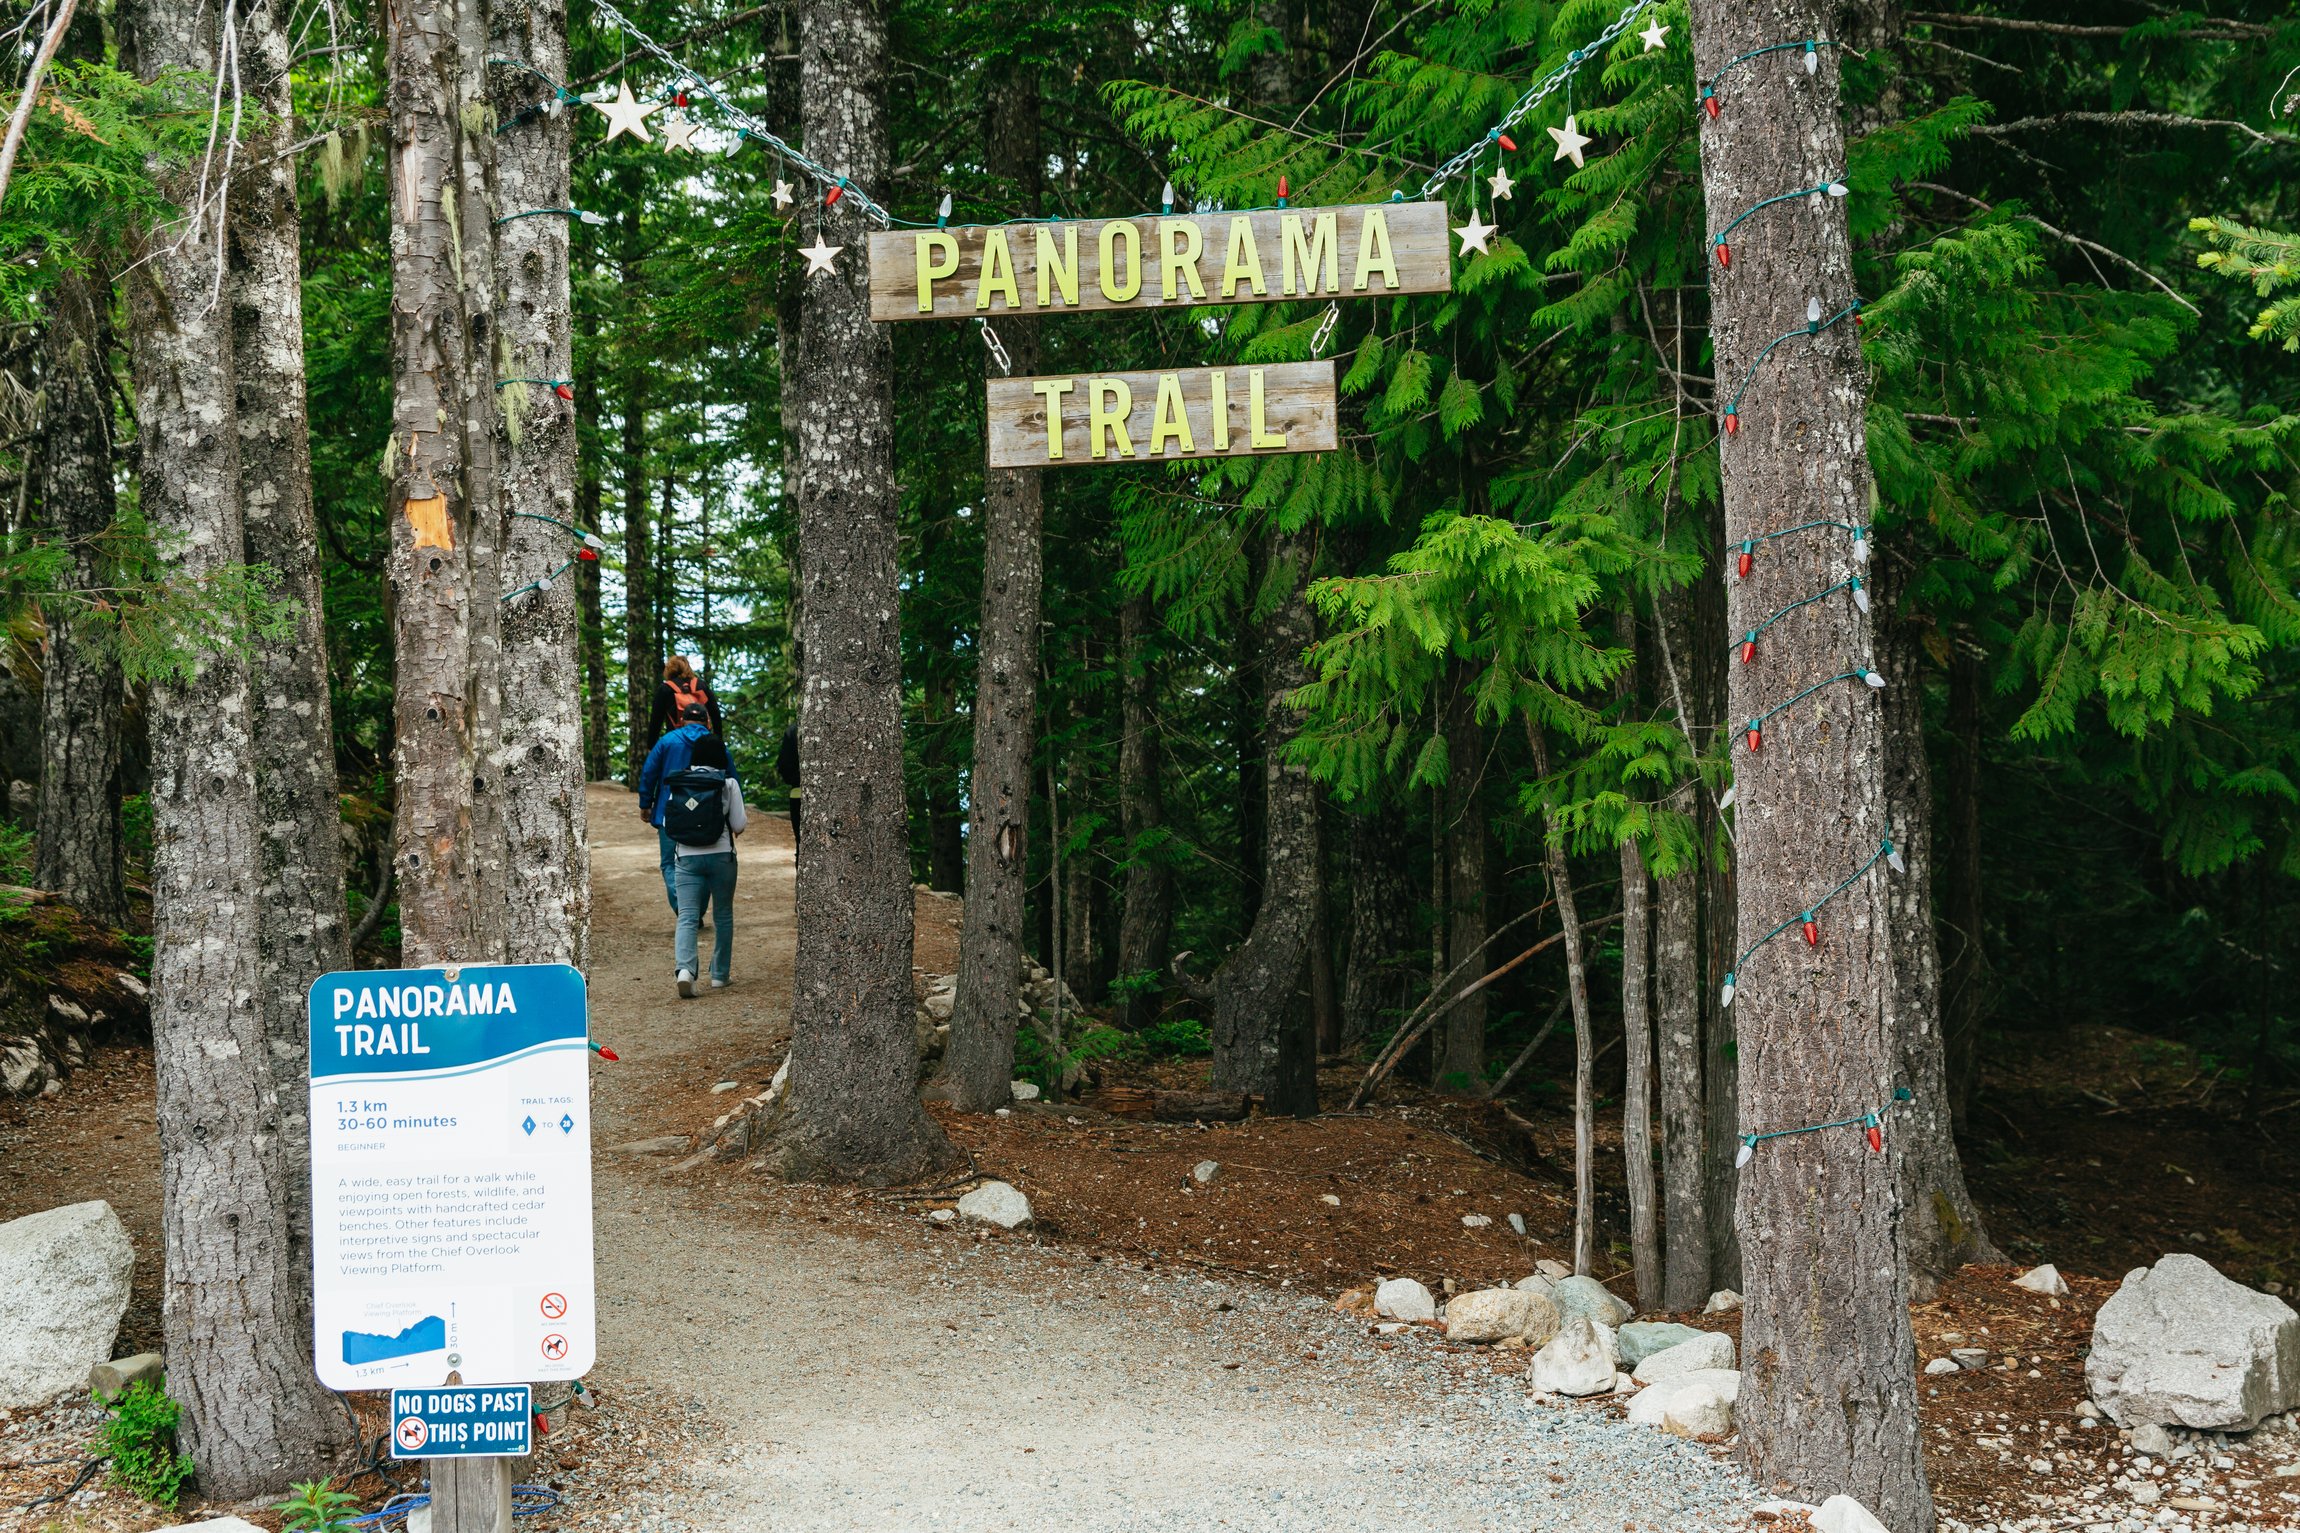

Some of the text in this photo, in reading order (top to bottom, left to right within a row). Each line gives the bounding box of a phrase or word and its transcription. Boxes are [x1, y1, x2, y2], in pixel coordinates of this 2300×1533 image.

[915, 209, 1400, 312] PANORAMA
[1033, 369, 1287, 459] TRAIL
[333, 983, 517, 1020] PANORAMA
[334, 1023, 430, 1056] TRAIL
[337, 1100, 387, 1113] 1.3 km
[337, 1115, 457, 1130] 30-60 minutes
[337, 1143, 386, 1151] BEGINNER
[339, 1178, 348, 1187] A
[351, 1177, 383, 1188] wide,
[386, 1177, 412, 1188] easy
[417, 1175, 439, 1185] trail
[443, 1174, 460, 1184] for
[473, 1173, 501, 1183] walk
[505, 1172, 536, 1181] while
[338, 1186, 545, 1204] enjoying open forests, wildlife, and
[339, 1201, 545, 1218] viewpoints with handcrafted cedar
[339, 1216, 528, 1231] benches. Other features include
[339, 1230, 540, 1248] interpretive signs and spectacular
[340, 1245, 520, 1260] views from the Chief Overlook
[341, 1262, 445, 1276] Viewing Platform.
[450, 1336, 457, 1348] 30
[356, 1367, 384, 1378] 1.3 km
[398, 1392, 525, 1414] NO DOGS PAST
[429, 1421, 525, 1442] THIS POINT
